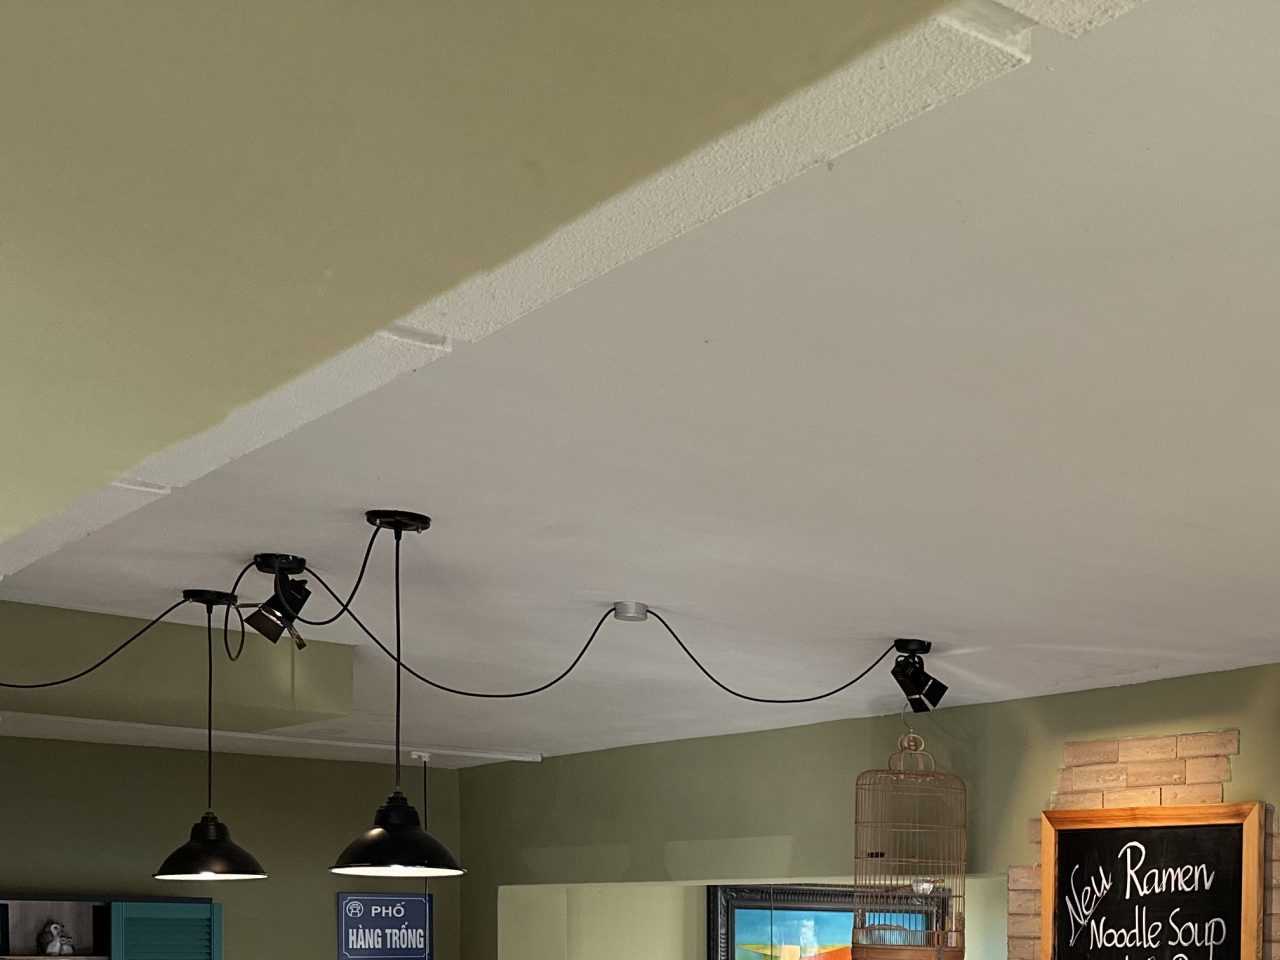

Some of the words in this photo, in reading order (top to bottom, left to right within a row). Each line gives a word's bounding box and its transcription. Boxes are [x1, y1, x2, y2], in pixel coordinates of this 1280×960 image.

[1117, 840, 1216, 900] Ramen
[371, 901, 406, 918] PHỐ
[1089, 904, 1163, 951] Noodle
[348, 923, 382, 949] HÀNG
[384, 921, 425, 949] TRỐNG
